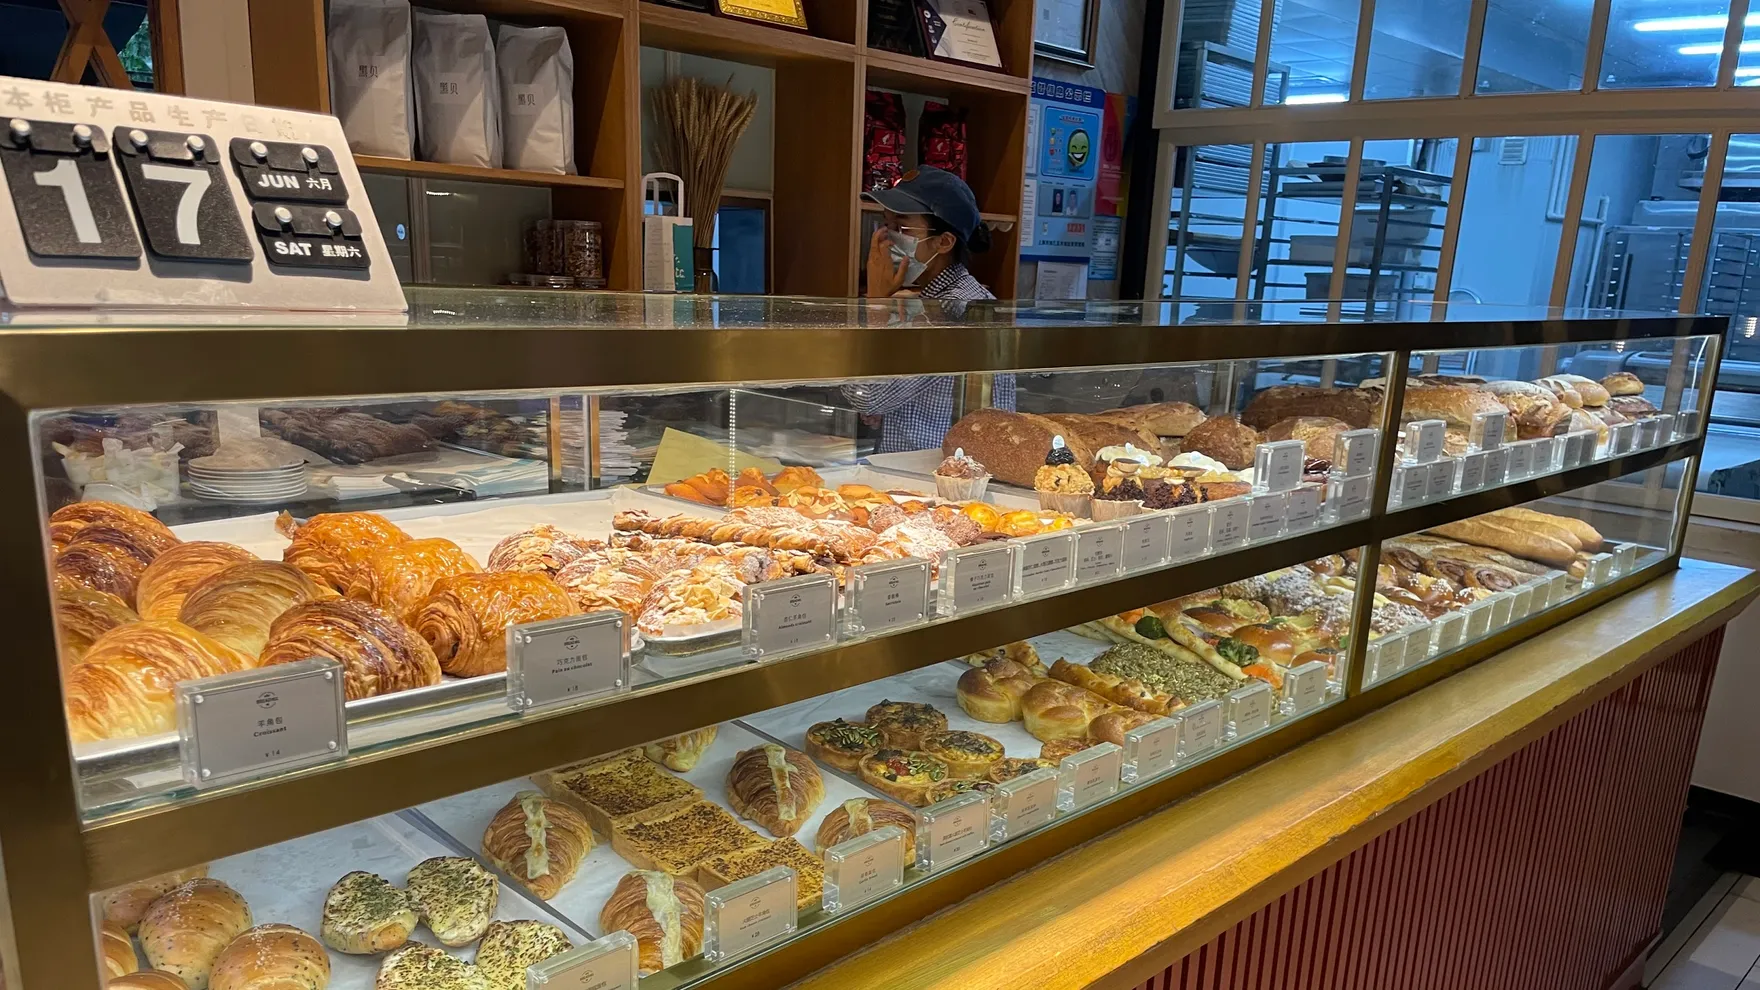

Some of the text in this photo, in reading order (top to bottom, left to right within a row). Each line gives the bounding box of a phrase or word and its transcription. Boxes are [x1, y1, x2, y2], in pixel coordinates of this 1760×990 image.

[258, 173, 301, 190] JUN
[306, 176, 334, 192] 六月
[275, 241, 312, 257] SAT
[322, 244, 363, 259] 星期六
[253, 726, 287, 738] Croissant
